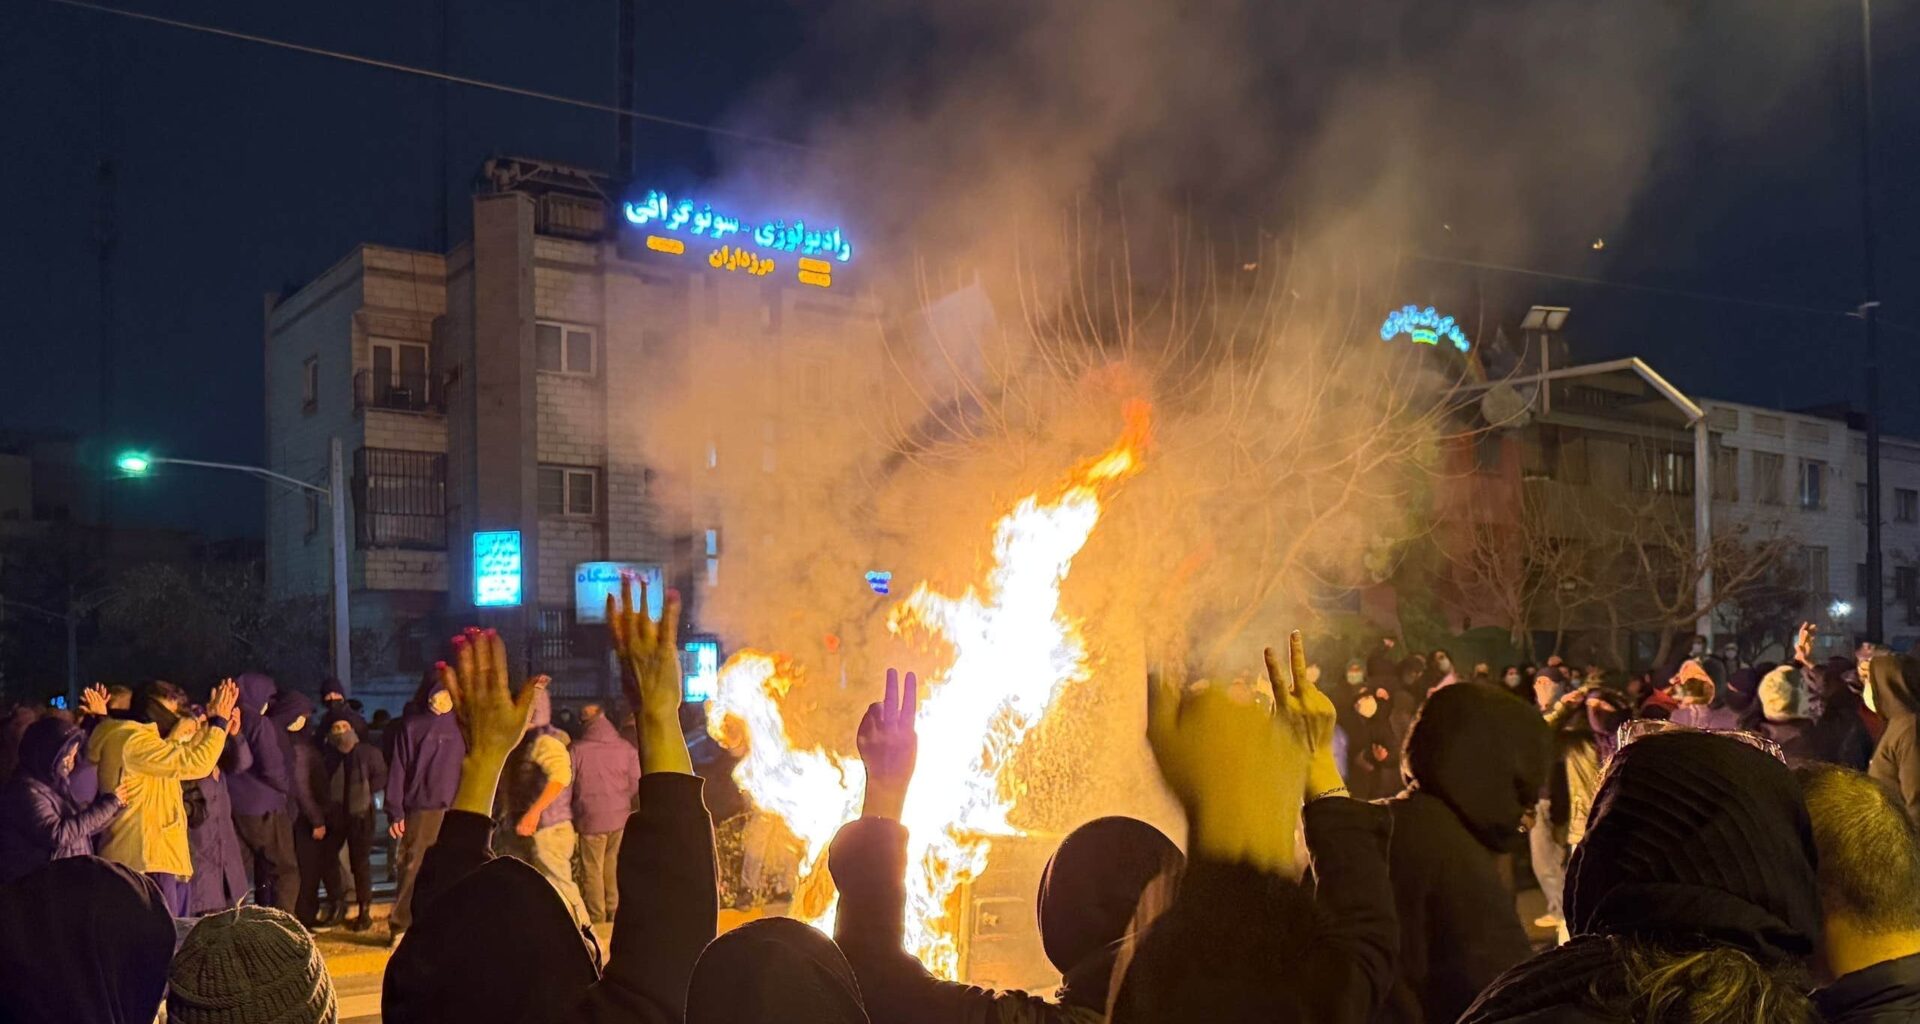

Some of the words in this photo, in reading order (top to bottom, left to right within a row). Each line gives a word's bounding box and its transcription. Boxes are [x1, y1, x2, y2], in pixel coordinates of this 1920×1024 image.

[624, 189, 740, 239] سونوگرافی
[708, 245, 775, 276] مرزداران
[754, 219, 852, 262] رادیولوژی
